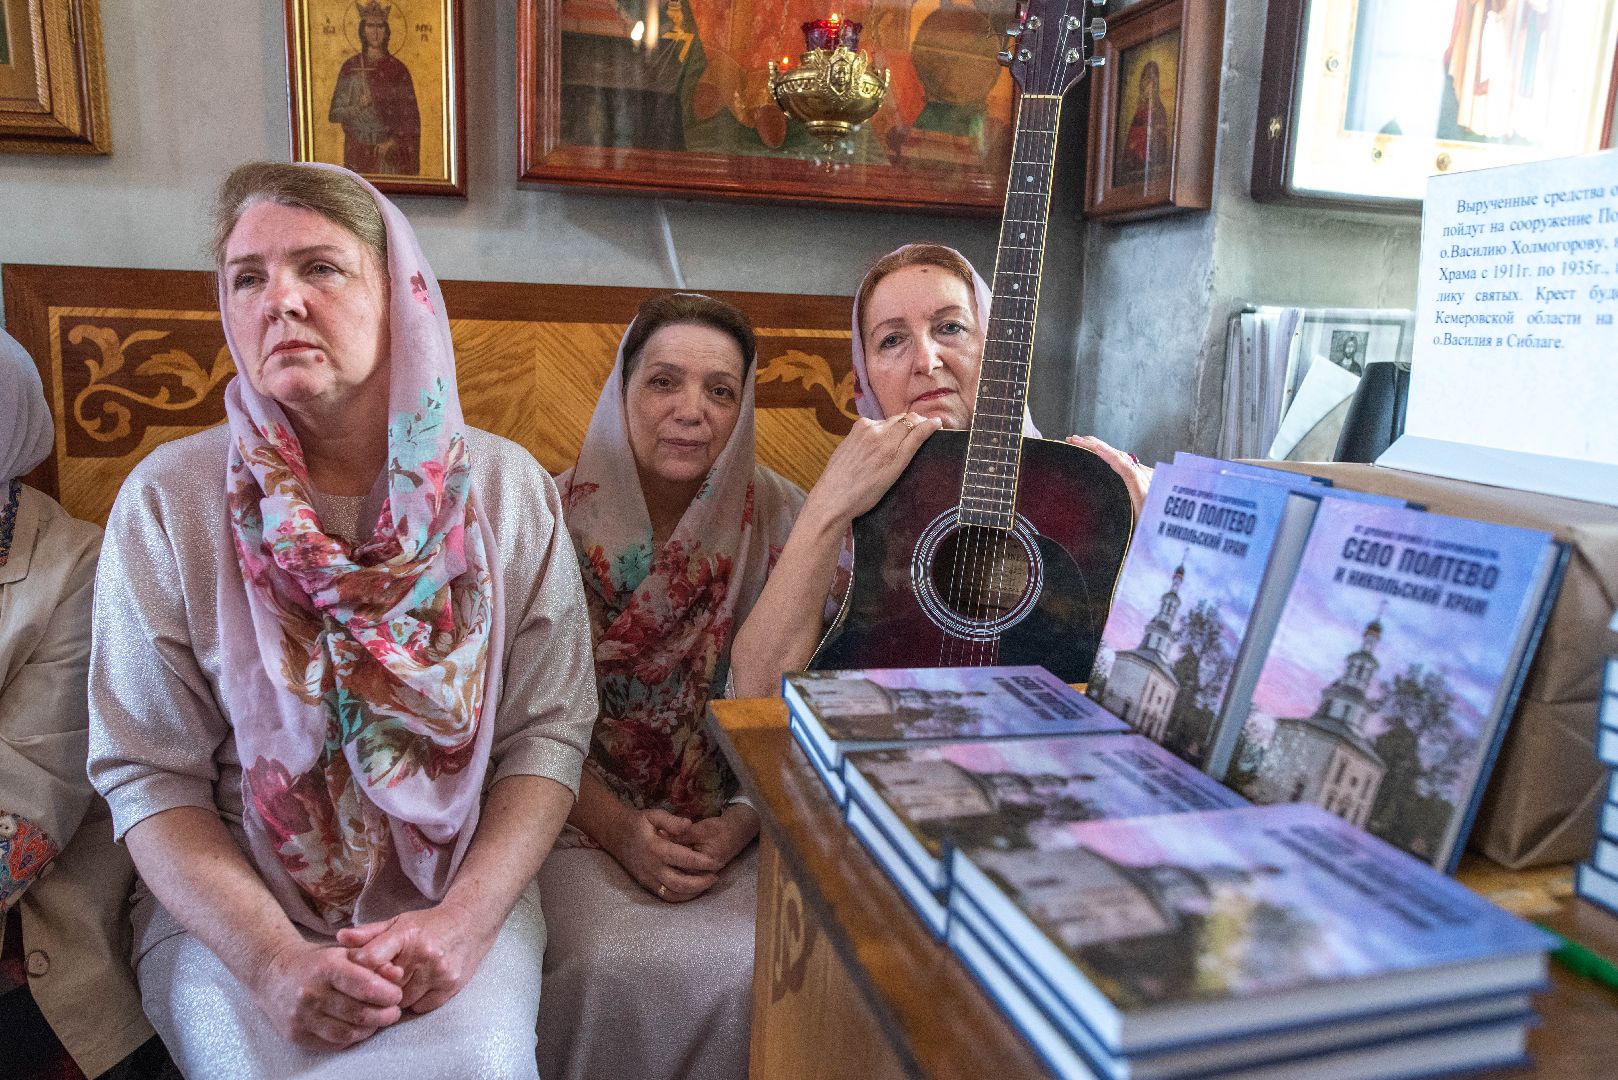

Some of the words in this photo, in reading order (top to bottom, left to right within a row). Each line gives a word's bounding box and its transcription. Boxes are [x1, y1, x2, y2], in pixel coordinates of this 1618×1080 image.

[1456, 195, 1538, 215] Вырученные
[1543, 187, 1605, 207] средства
[1442, 222, 1485, 238] пойдут
[1490, 222, 1505, 233] на
[1510, 213, 1592, 233] сооружение
[1438, 267, 1477, 284] Храма
[1481, 269, 1489, 279] с
[1537, 265, 1555, 277] по
[1435, 292, 1464, 305] лику
[1475, 291, 1523, 302] святых.
[1535, 286, 1577, 305] Крест
[1434, 310, 1515, 328] Кемеровской
[1527, 309, 1582, 325] области
[1595, 313, 1614, 325] на
[1496, 337, 1504, 347] в
[1164, 496, 1197, 521] СЕЛО
[1197, 503, 1258, 536] ПОЛТЕВО
[1341, 536, 1395, 568] СЕЛО
[1398, 546, 1501, 592] ПОЛТЕВО
